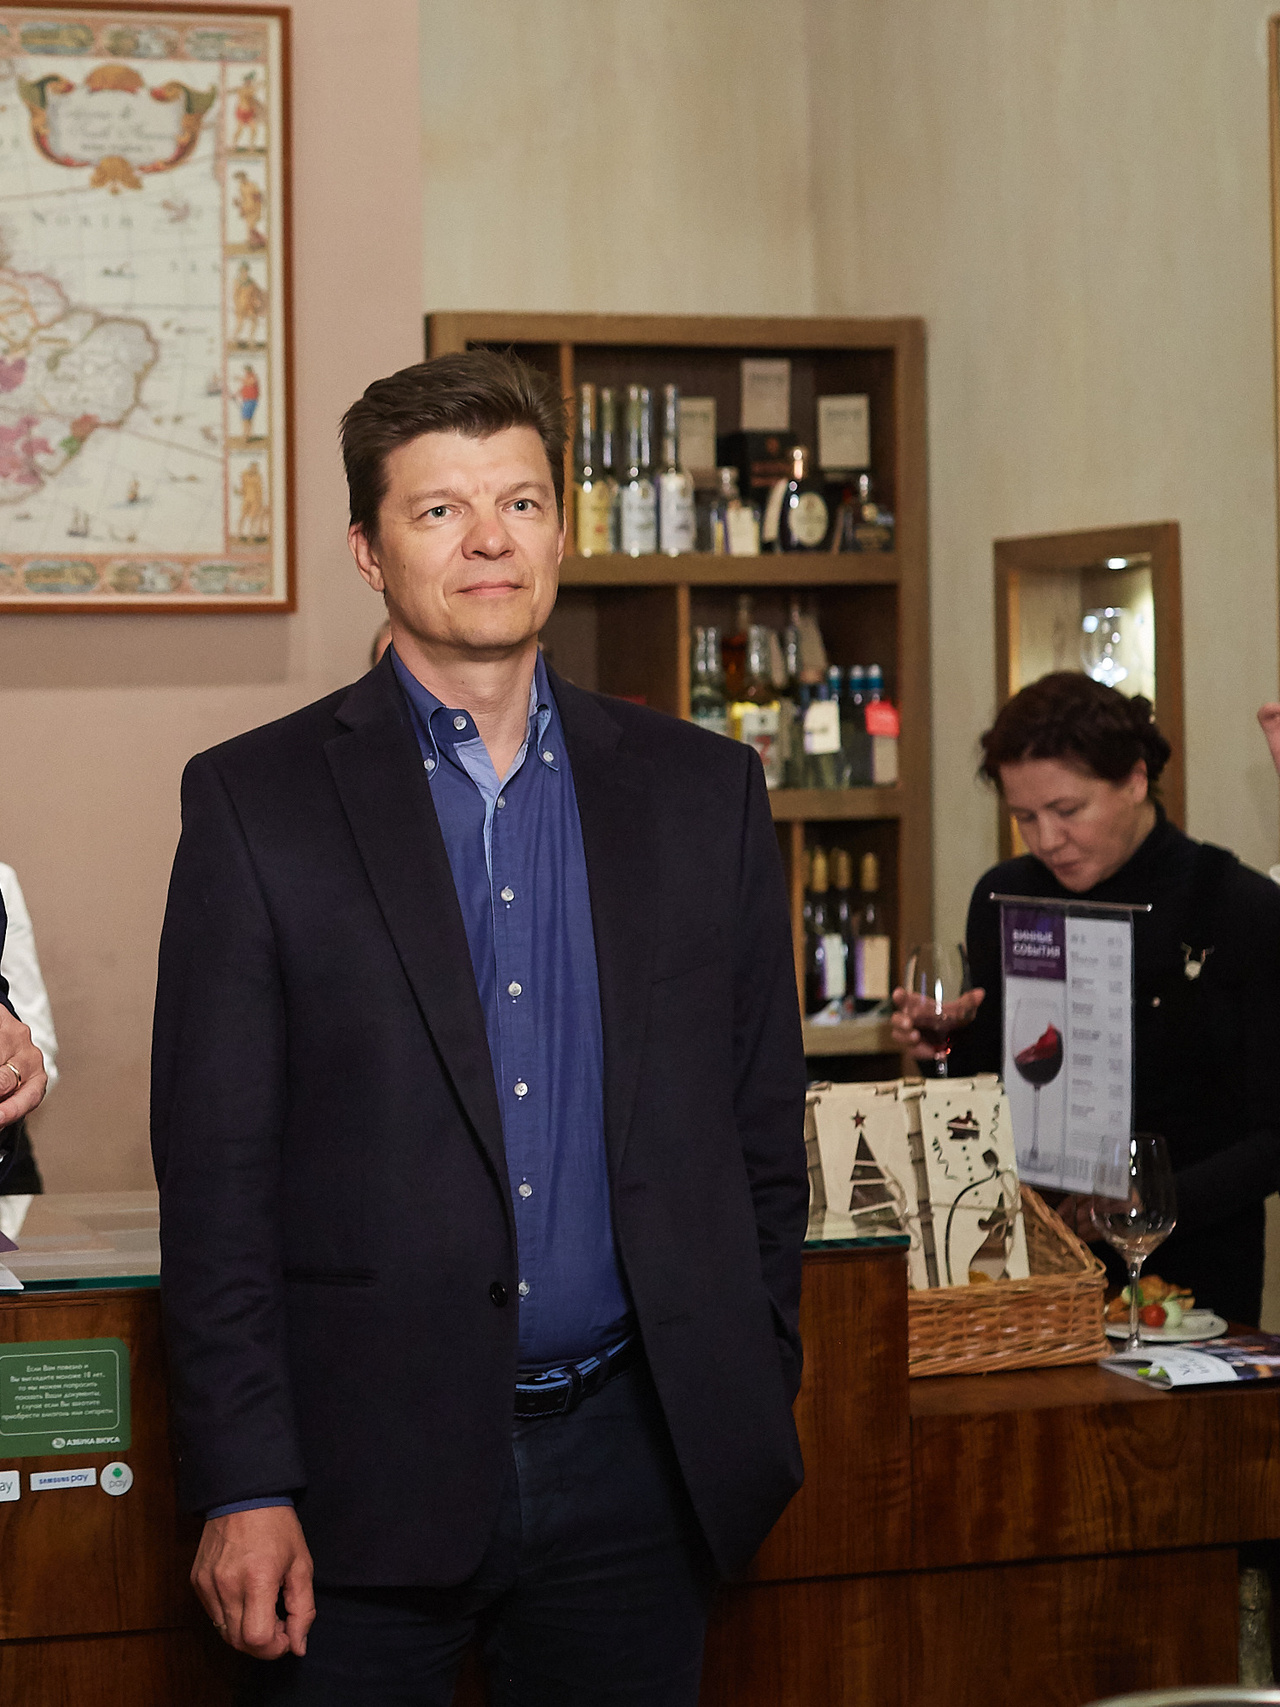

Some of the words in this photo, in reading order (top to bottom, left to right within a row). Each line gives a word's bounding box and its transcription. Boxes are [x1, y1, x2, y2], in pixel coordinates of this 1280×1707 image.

[1013, 929, 1053, 944] ВИННЫЕ
[1013, 942, 1060, 958] СОБЫТИЯ
[66, 1438, 95, 1446] АЗБУКА
[95, 1436, 120, 1444] ВКУСА
[39, 1475, 69, 1484] SAMSUNG
[71, 1473, 88, 1484] pay
